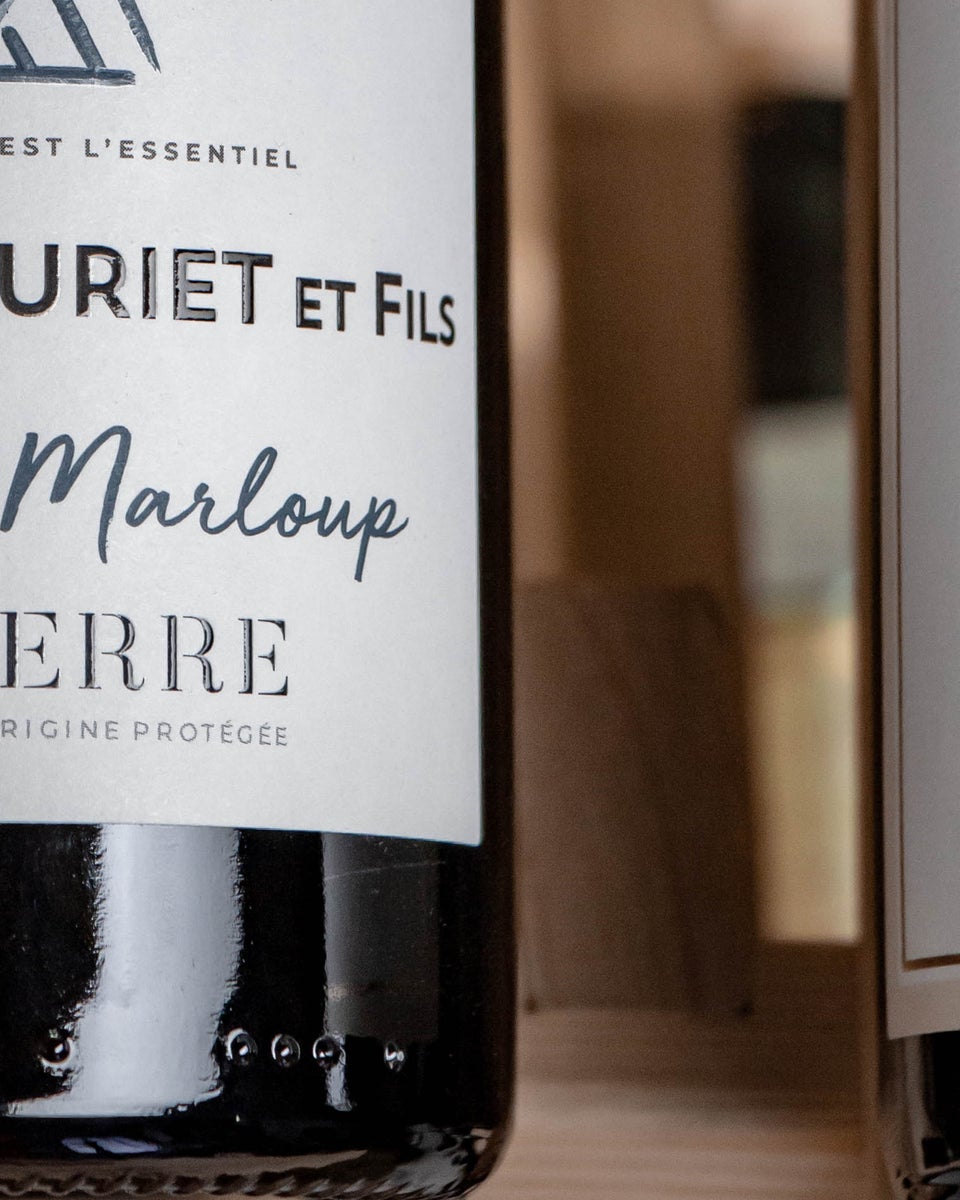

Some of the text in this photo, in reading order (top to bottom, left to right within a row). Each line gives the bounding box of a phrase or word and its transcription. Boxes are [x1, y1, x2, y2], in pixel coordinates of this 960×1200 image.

[295, 276, 357, 333] ET
[0, 424, 410, 583] Marloup
[134, 720, 288, 747] PROTÉGÉE
